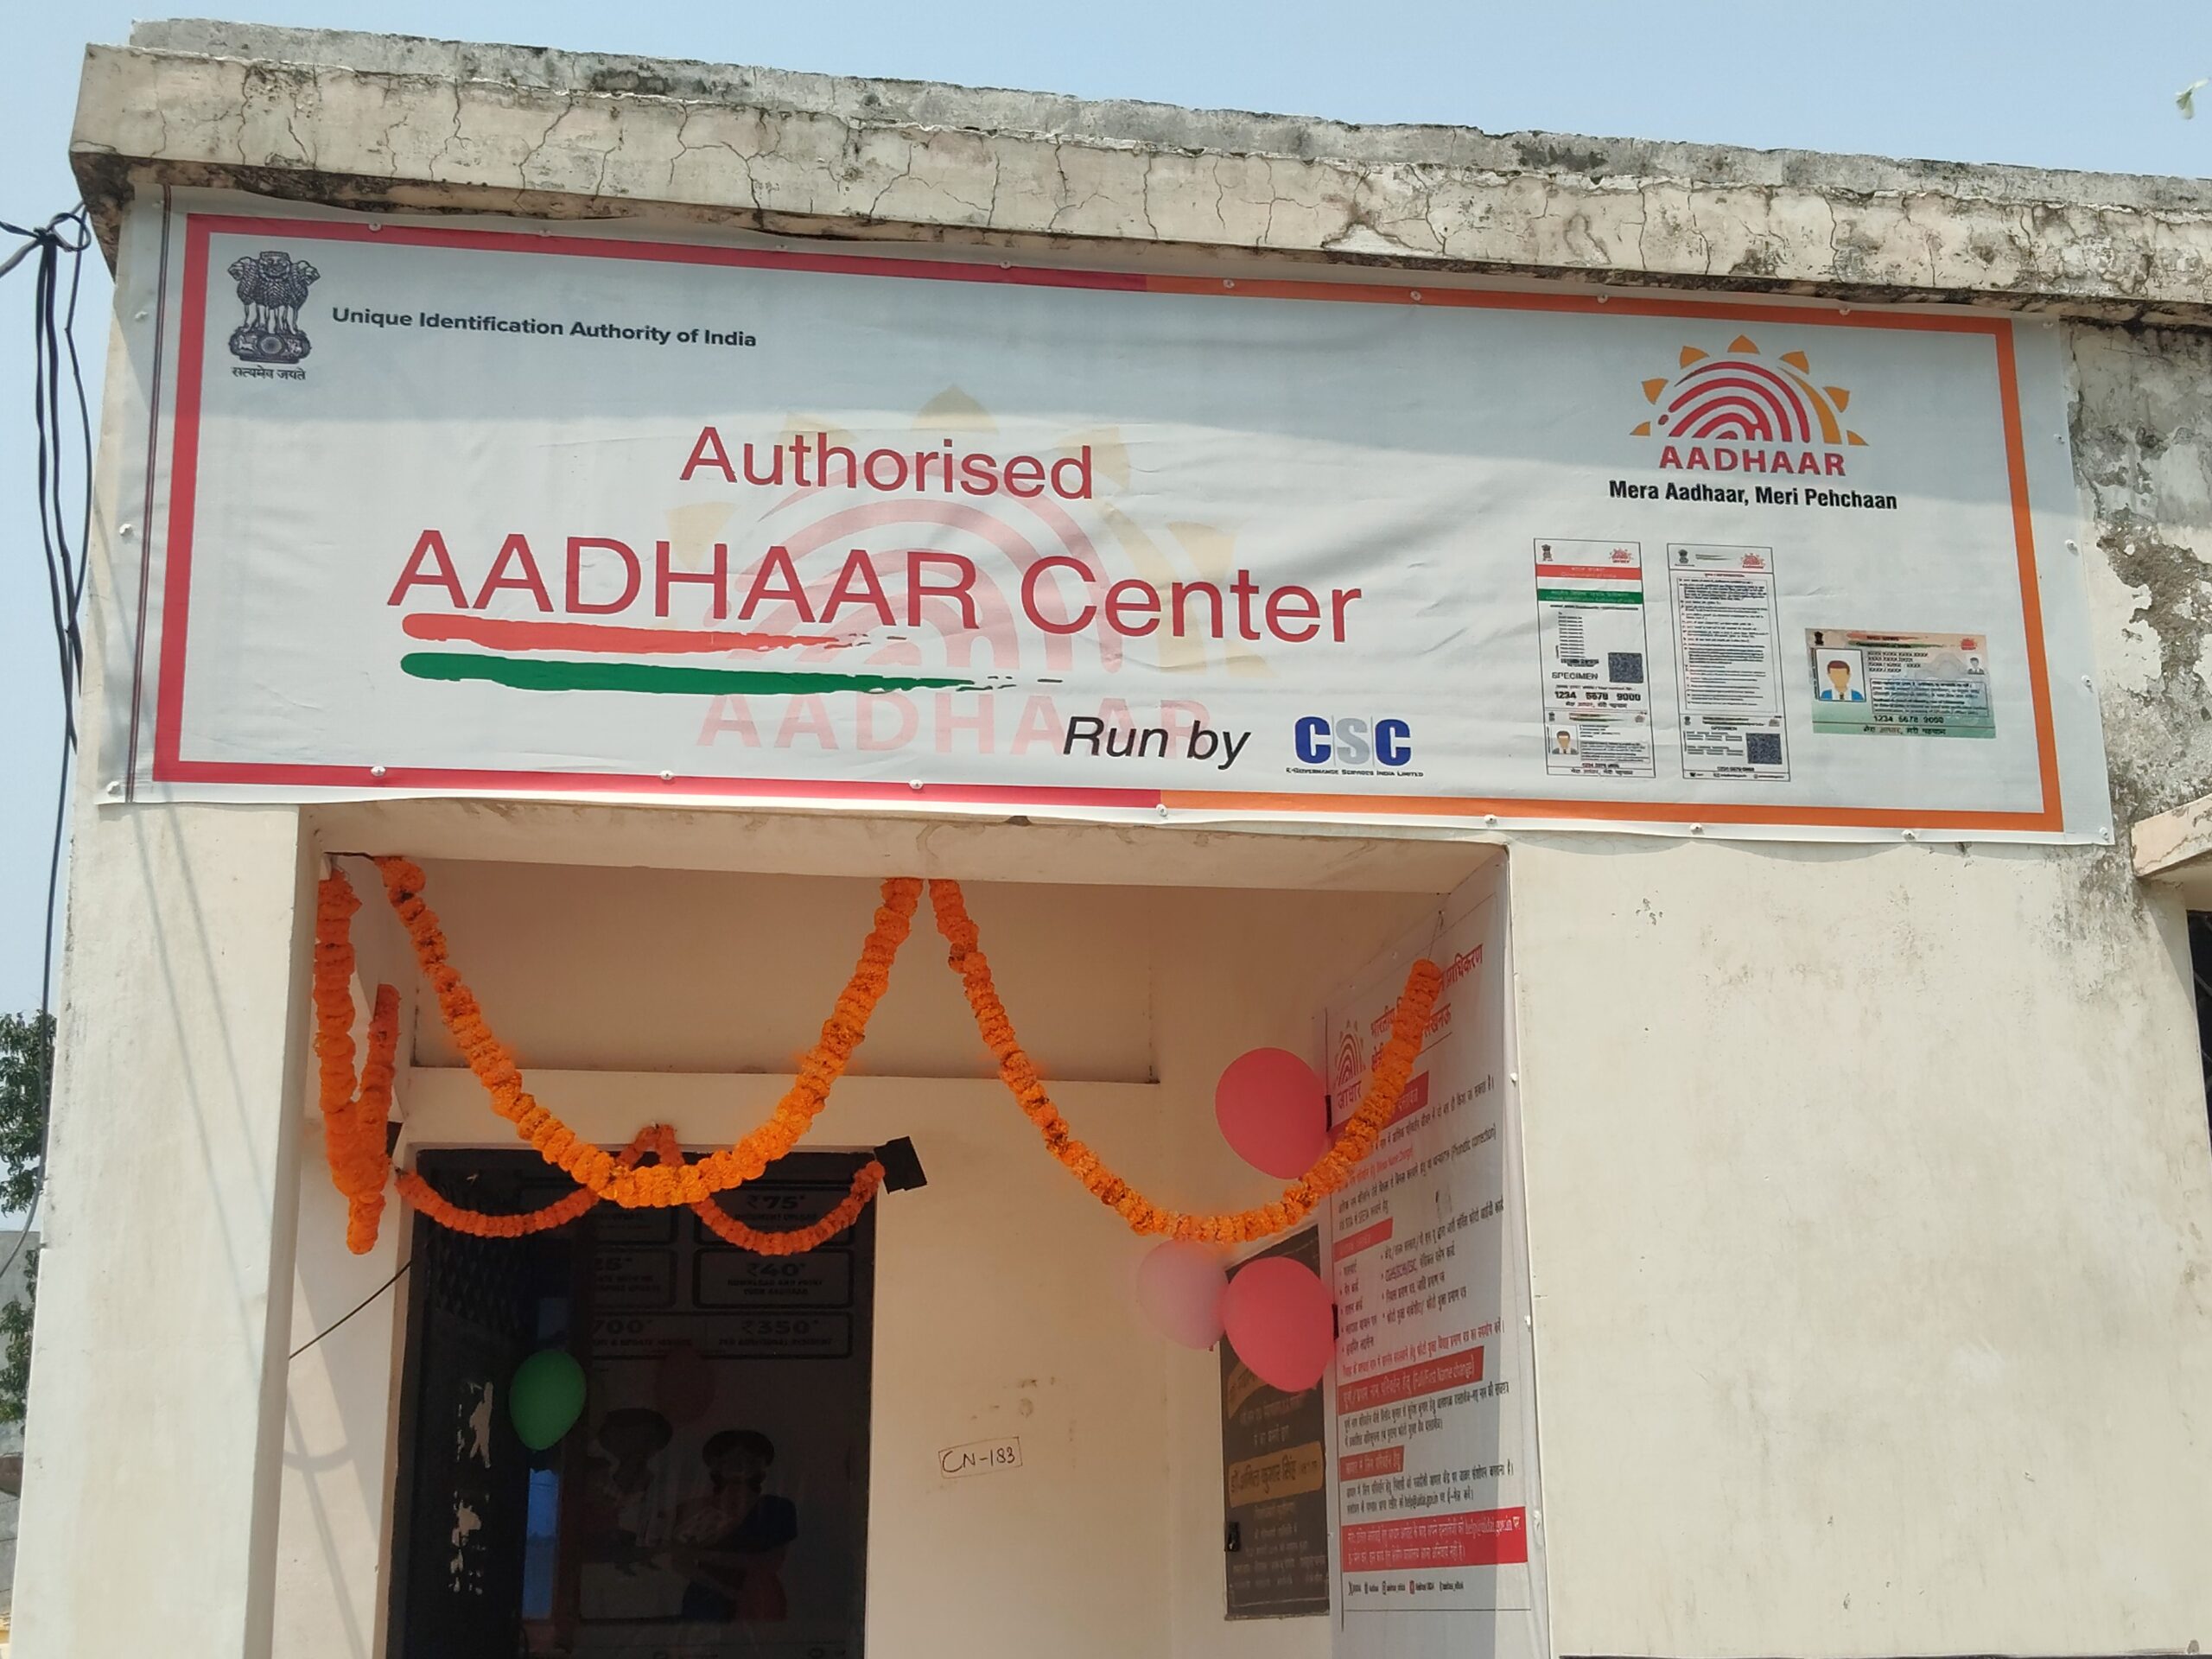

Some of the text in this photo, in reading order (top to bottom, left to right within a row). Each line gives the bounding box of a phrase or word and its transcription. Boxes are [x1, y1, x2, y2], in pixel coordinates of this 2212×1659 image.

[333, 307, 757, 347] Unique Identification Authority of India
[231, 365, 307, 381] सत्यमेव जयते
[679, 426, 1092, 499] Authorised
[1658, 445, 1847, 477] AADHAAR
[1609, 480, 1897, 510] Mera Aadhaar, Meri Pehchaan
[387, 529, 1362, 643] AADHAAR Center
[1551, 671, 1599, 680] SPECIMEN
[1554, 690, 1577, 699] 1234
[1063, 715, 1252, 771] Run by
[1294, 715, 1412, 767] CSC
[942, 1446, 1016, 1473] CN-183
